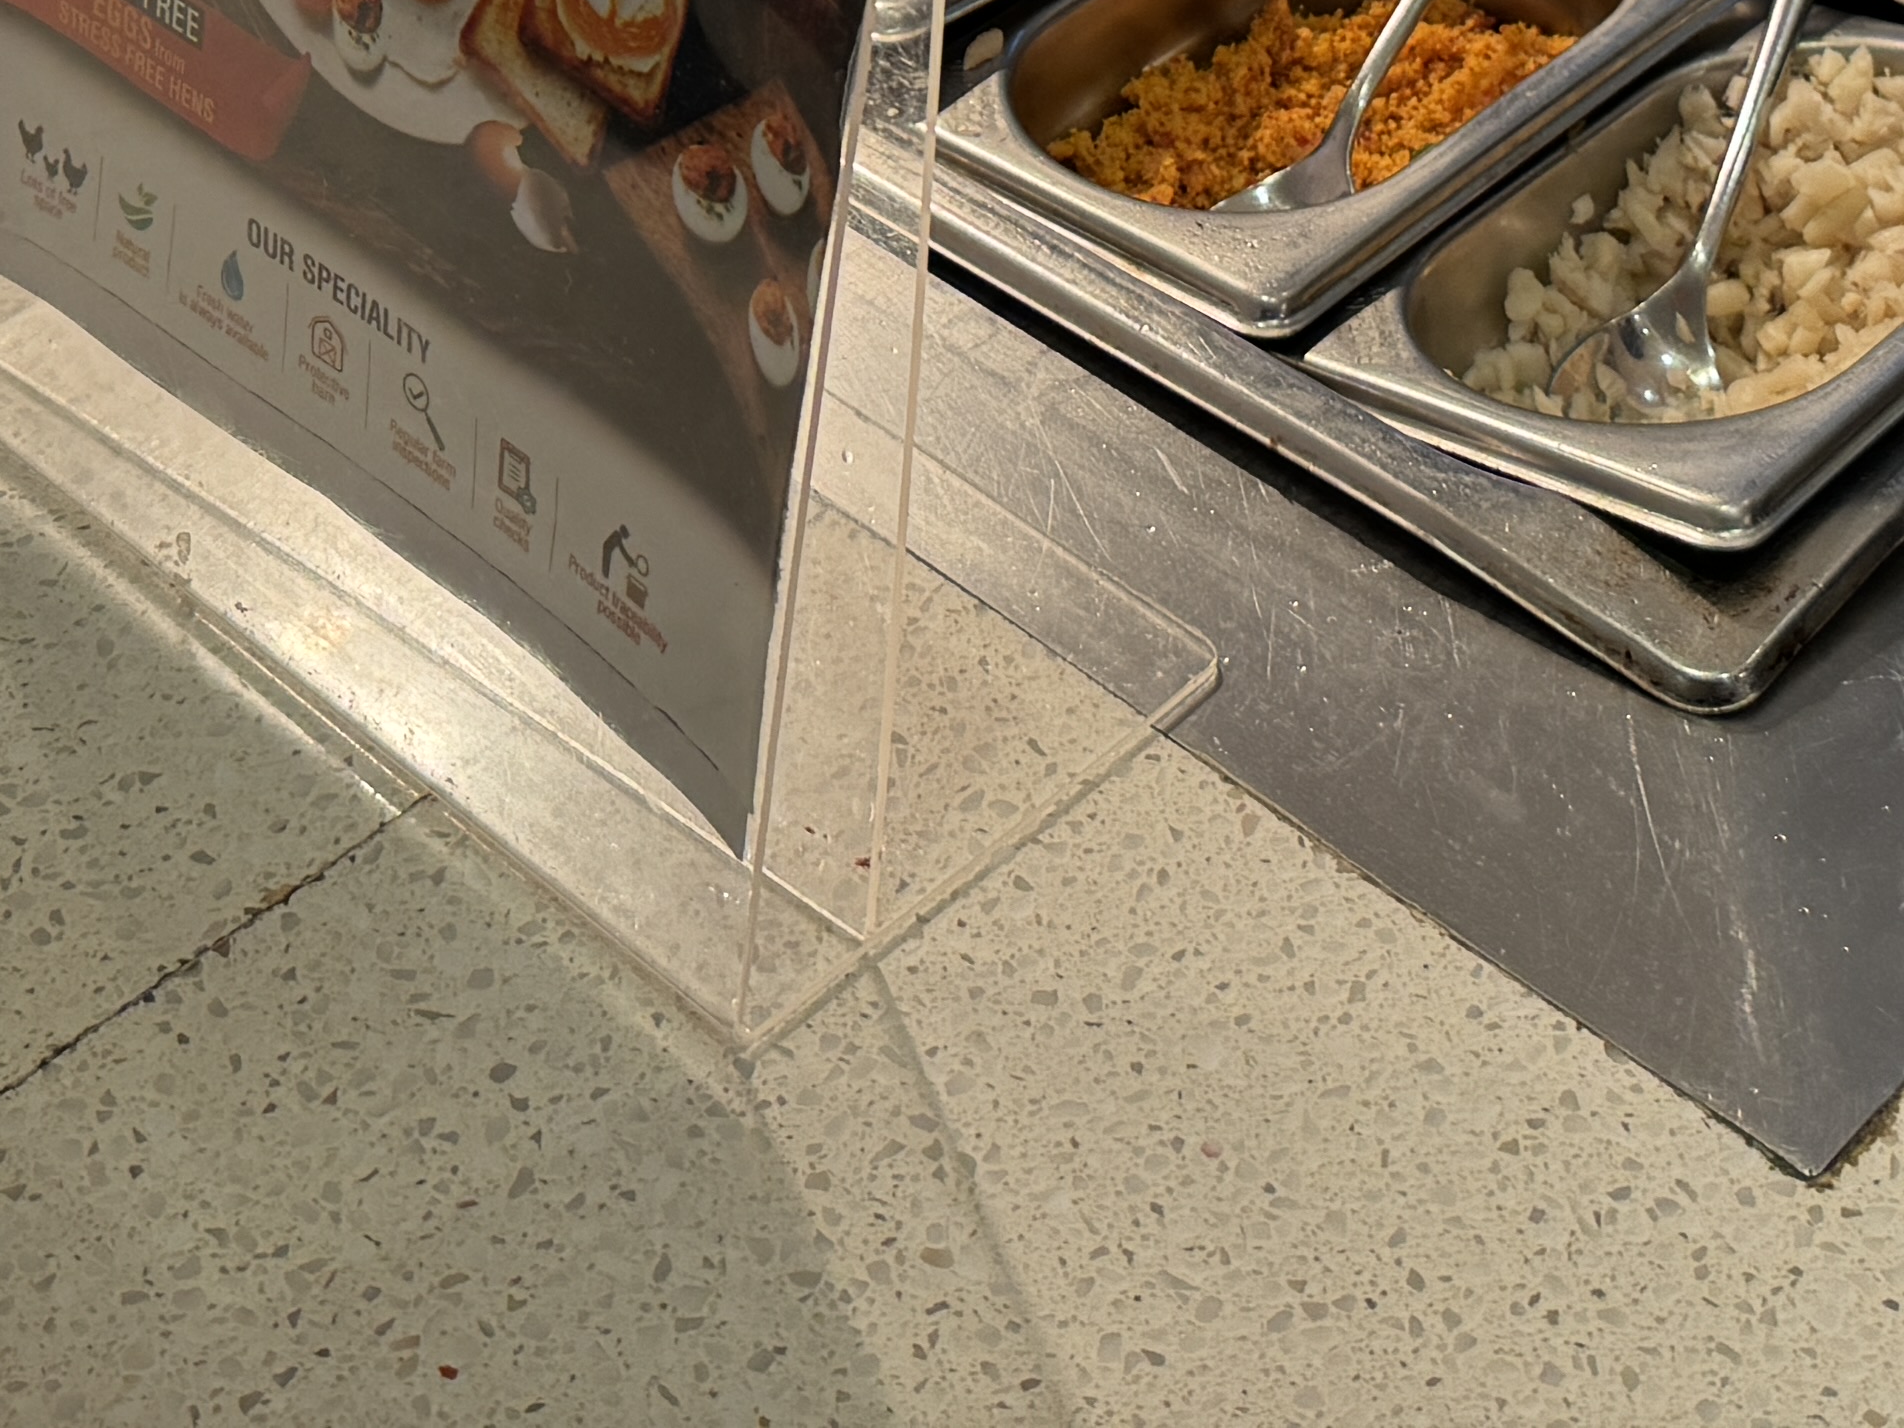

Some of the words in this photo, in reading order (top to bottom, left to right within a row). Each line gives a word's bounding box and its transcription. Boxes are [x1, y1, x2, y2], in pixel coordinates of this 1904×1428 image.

[58, 0, 121, 59] STRESS
[125, 46, 166, 91] FREE
[169, 75, 215, 124] HENS
[155, 40, 186, 75] from
[247, 218, 294, 272] OUR
[302, 253, 430, 364] SPECIALITY
